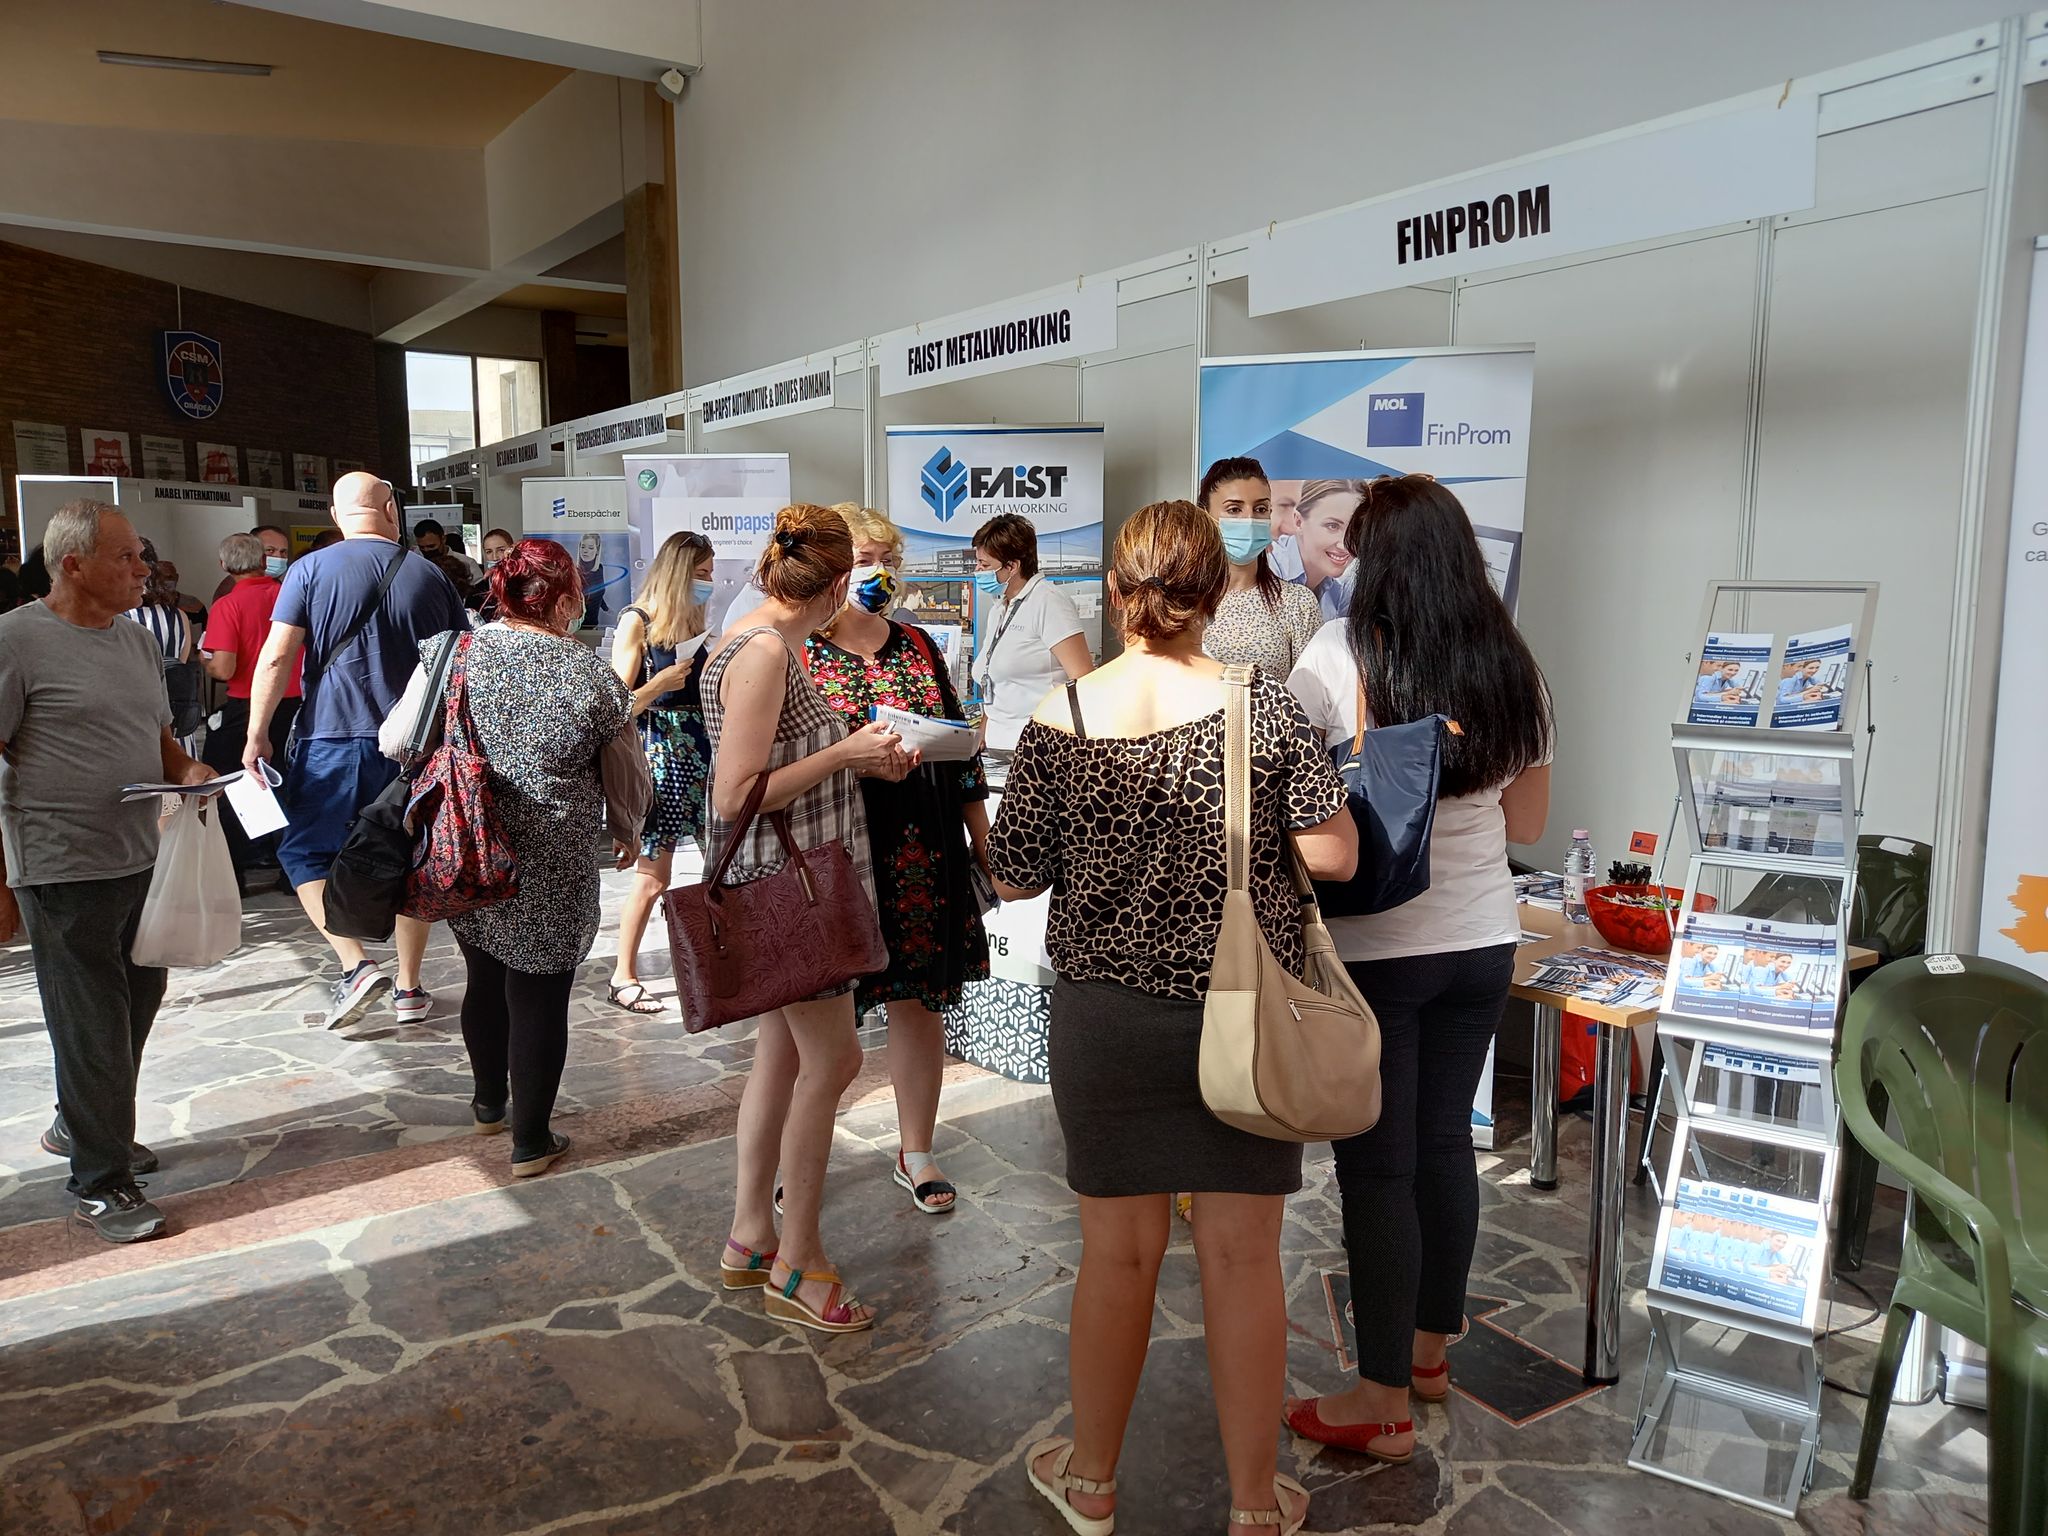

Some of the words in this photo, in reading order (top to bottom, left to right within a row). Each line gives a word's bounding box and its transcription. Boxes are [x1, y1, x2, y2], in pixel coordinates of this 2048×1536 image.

[1397, 184, 1551, 265] FINPROM
[908, 340, 943, 376] FAIST
[946, 309, 1071, 368] METALWORKING
[180, 350, 209, 364] CSM
[703, 396, 732, 424] EBM-PAPST
[732, 386, 768, 416] AUTOMOTIVE
[769, 388, 774, 408] &
[774, 378, 799, 407] DRIVES
[799, 370, 831, 402] ROMANIA
[183, 402, 213, 412] ORADEA
[1373, 398, 1408, 411] MOL
[1427, 423, 1511, 446] FinProm
[154, 487, 182, 500] ANABEL
[182, 489, 231, 502] INTERNATIONAL
[299, 498, 328, 511] ARABESQUE
[970, 503, 1068, 514] METALWORKING
[567, 509, 621, 519] Eberspächer
[701, 512, 776, 534] ebmpapst
